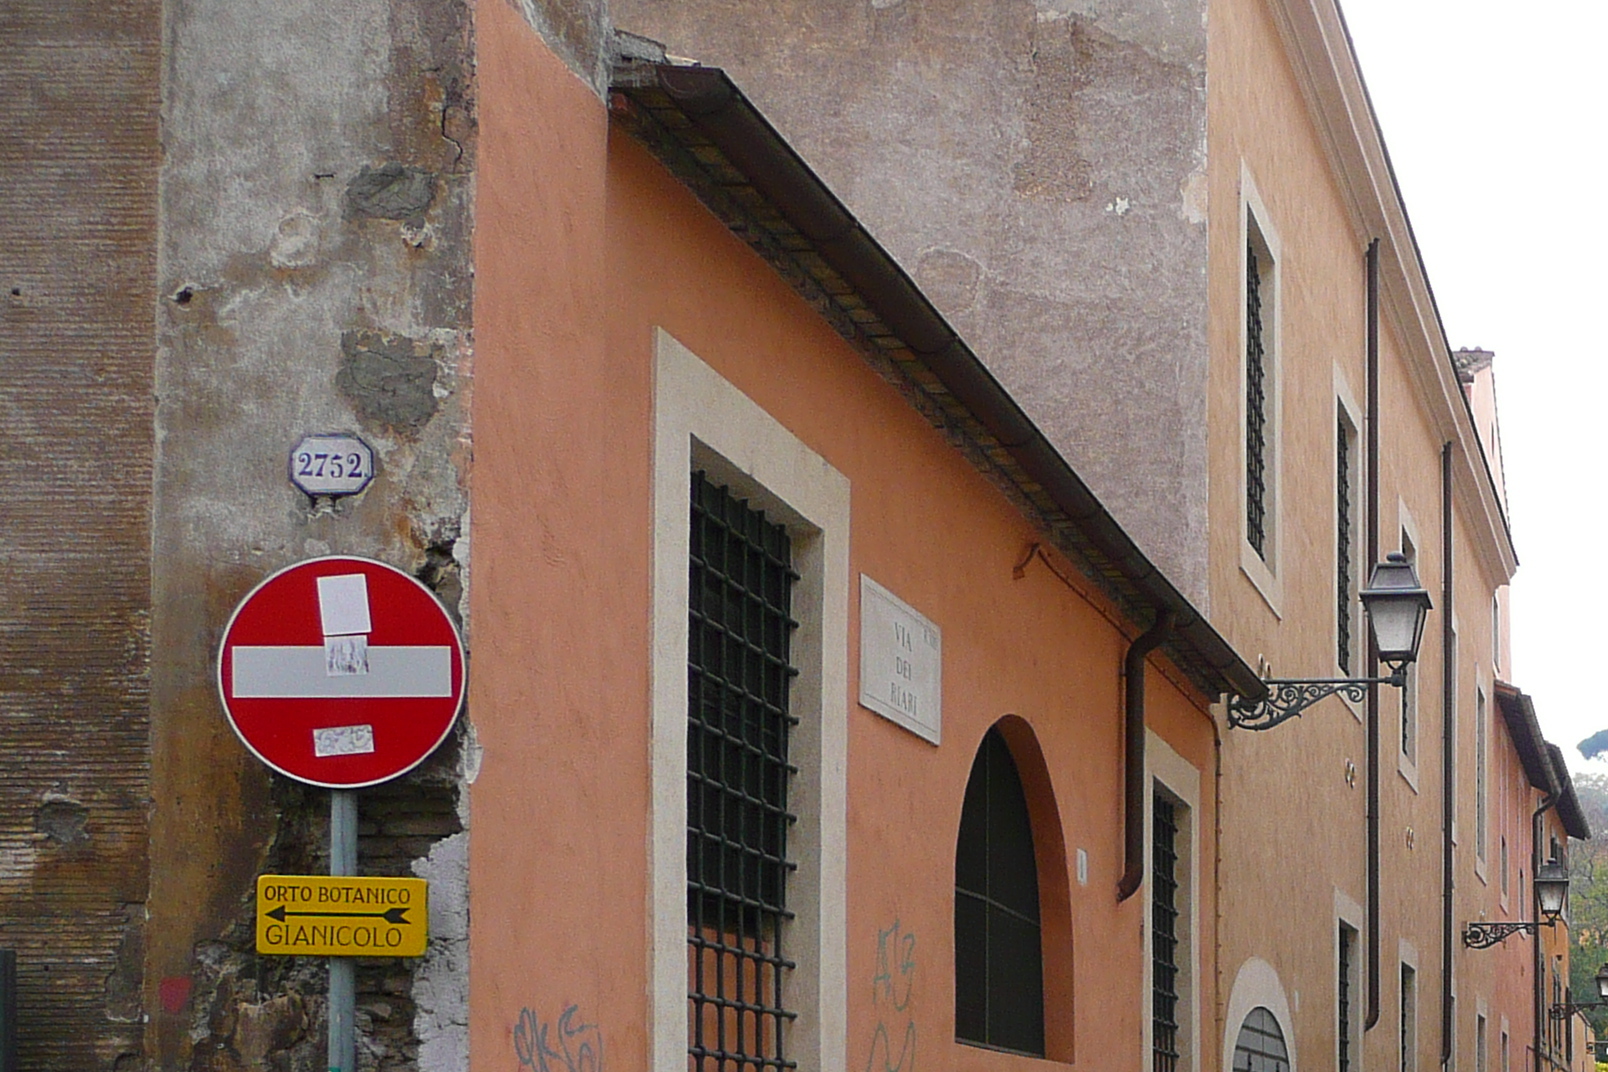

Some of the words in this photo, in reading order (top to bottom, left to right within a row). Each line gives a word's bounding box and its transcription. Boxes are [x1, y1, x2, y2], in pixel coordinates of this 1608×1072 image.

[894, 621, 912, 652] VIA
[895, 656, 912, 682] DEI
[890, 681, 917, 717] RIARI
[264, 885, 312, 902] ORTO
[318, 886, 411, 904] BOTANICO
[265, 924, 402, 948] GIANICOLO
